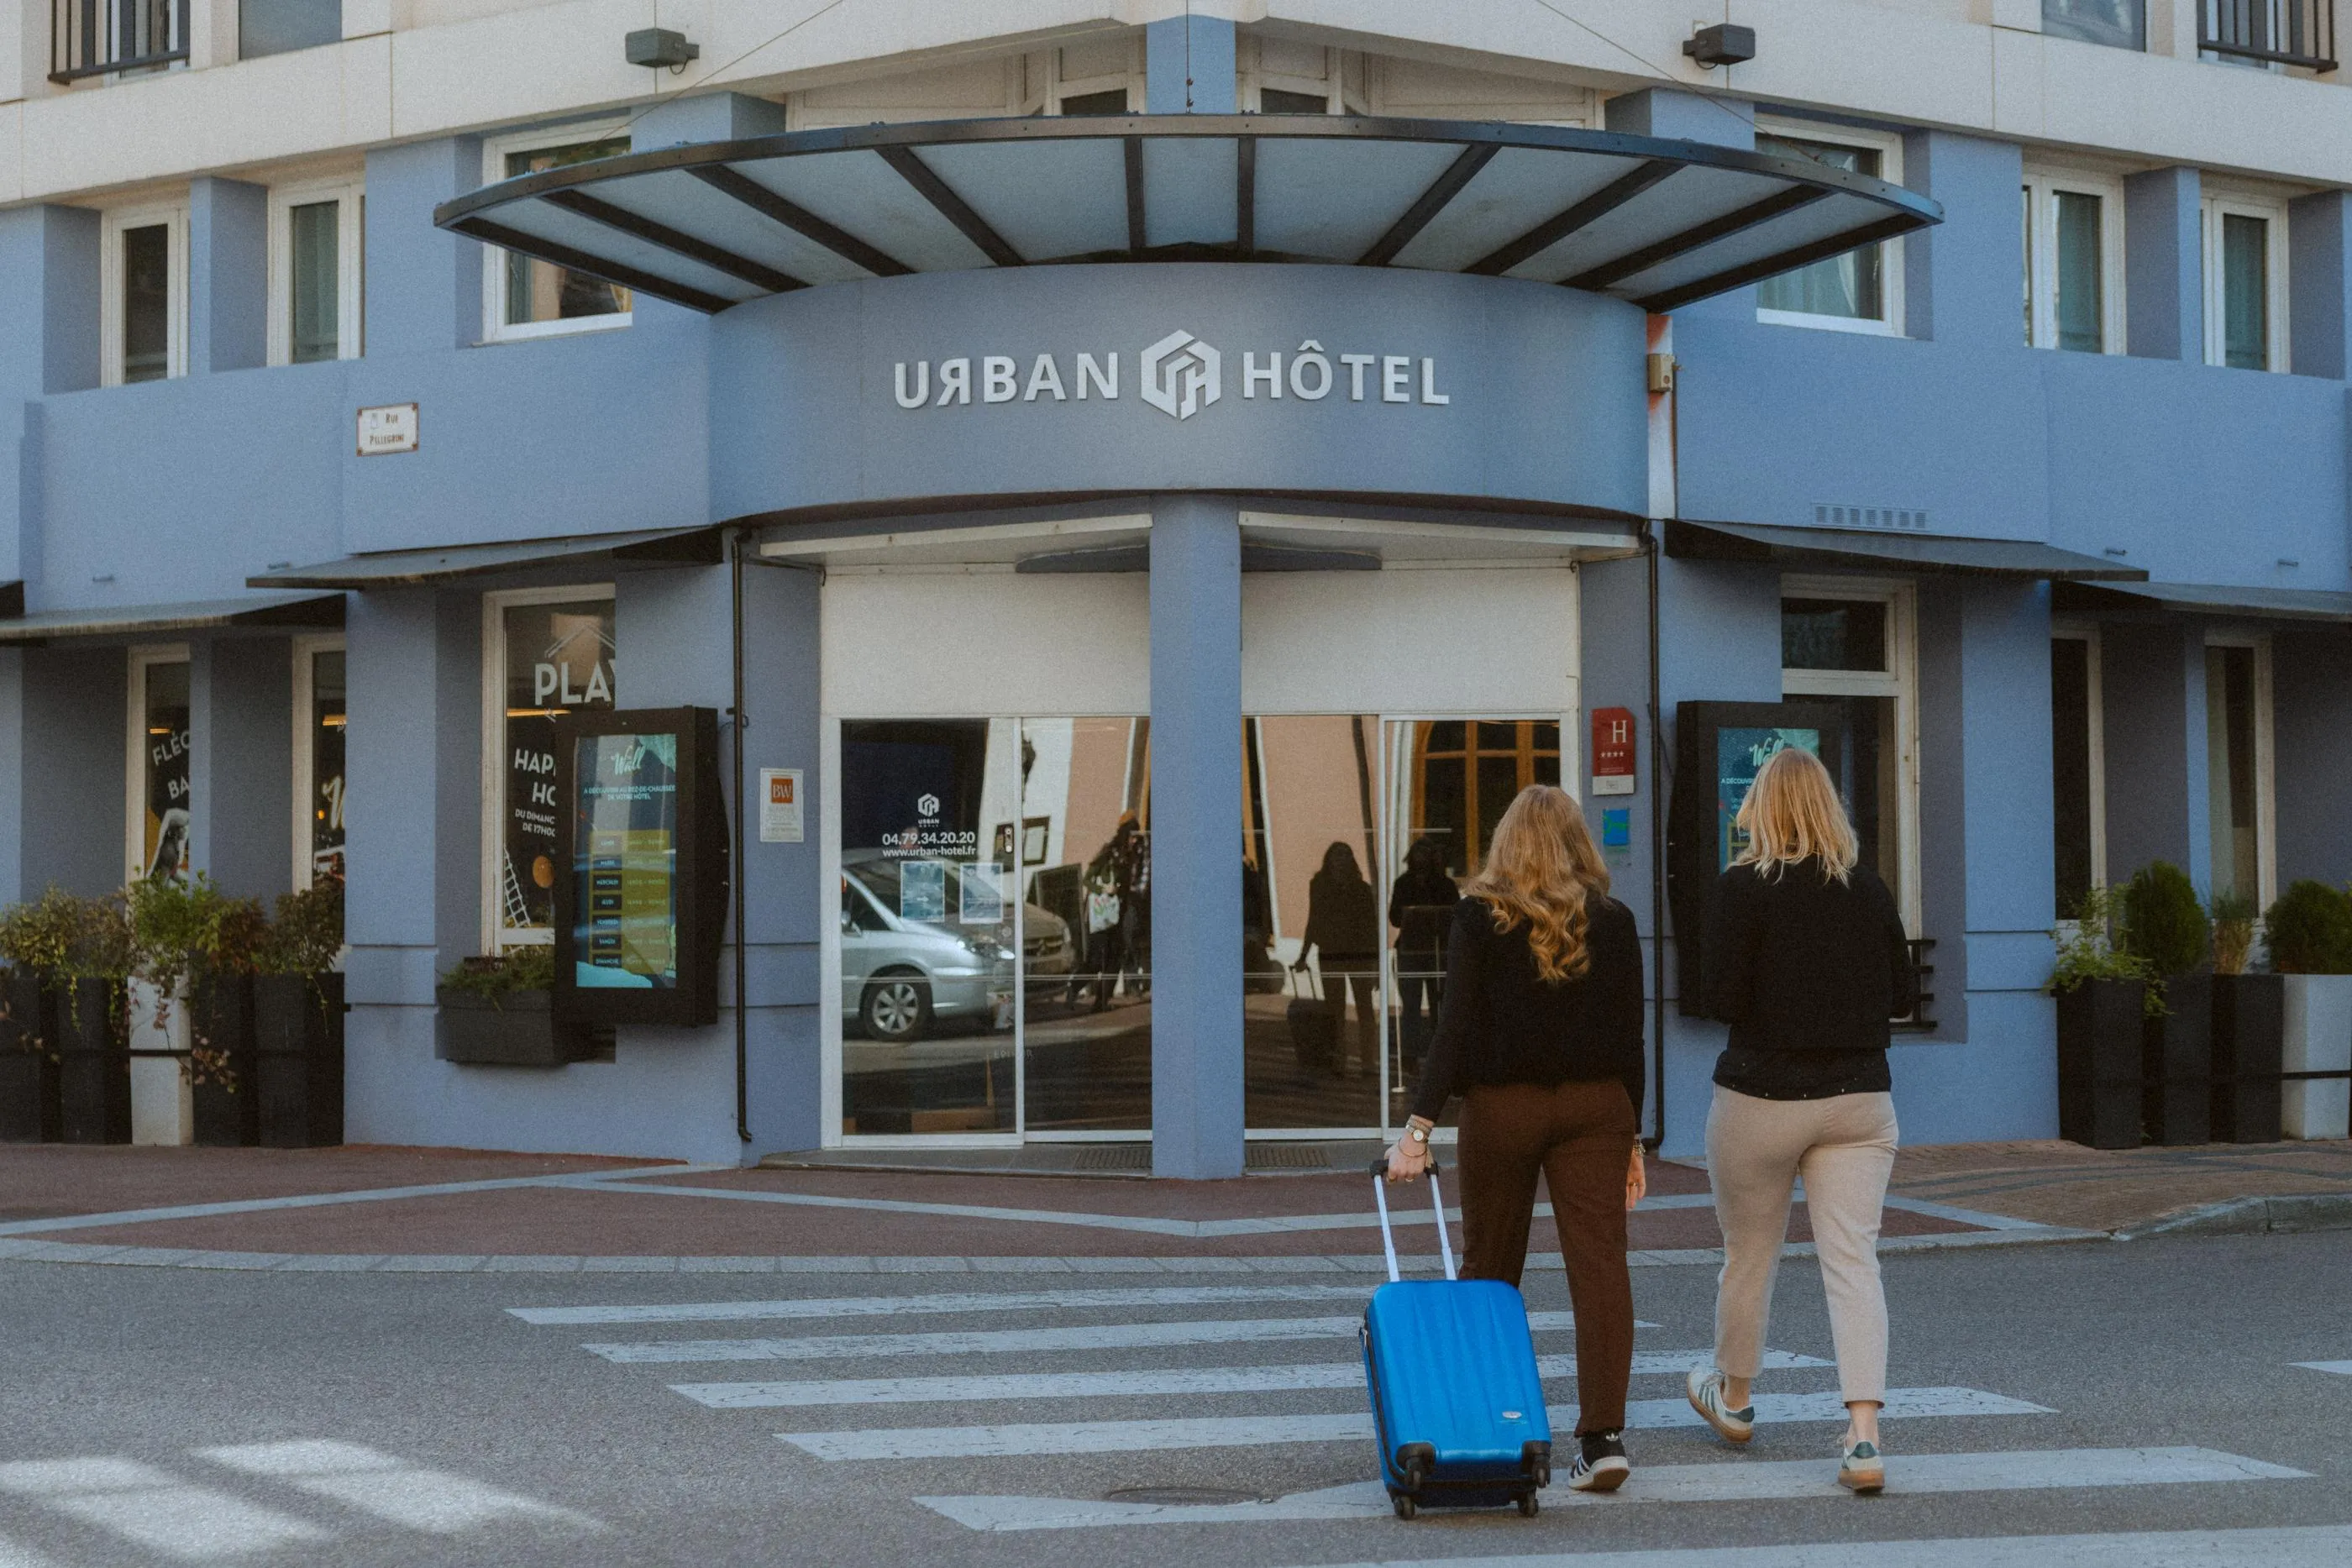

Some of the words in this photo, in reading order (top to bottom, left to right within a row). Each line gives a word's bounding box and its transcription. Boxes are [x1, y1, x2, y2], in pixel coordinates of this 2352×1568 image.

[894, 351, 1119, 410] URBAN
[1242, 338, 1450, 405] HÔTEL
[1612, 719, 1628, 744] H
[513, 747, 556, 777] HAP
[772, 784, 792, 800] BW
[515, 808, 527, 819] DU
[522, 822, 533, 833] DE
[881, 831, 976, 846] 04.79.34.20.20
[882, 845, 976, 857] www.urban-hotel.fr
